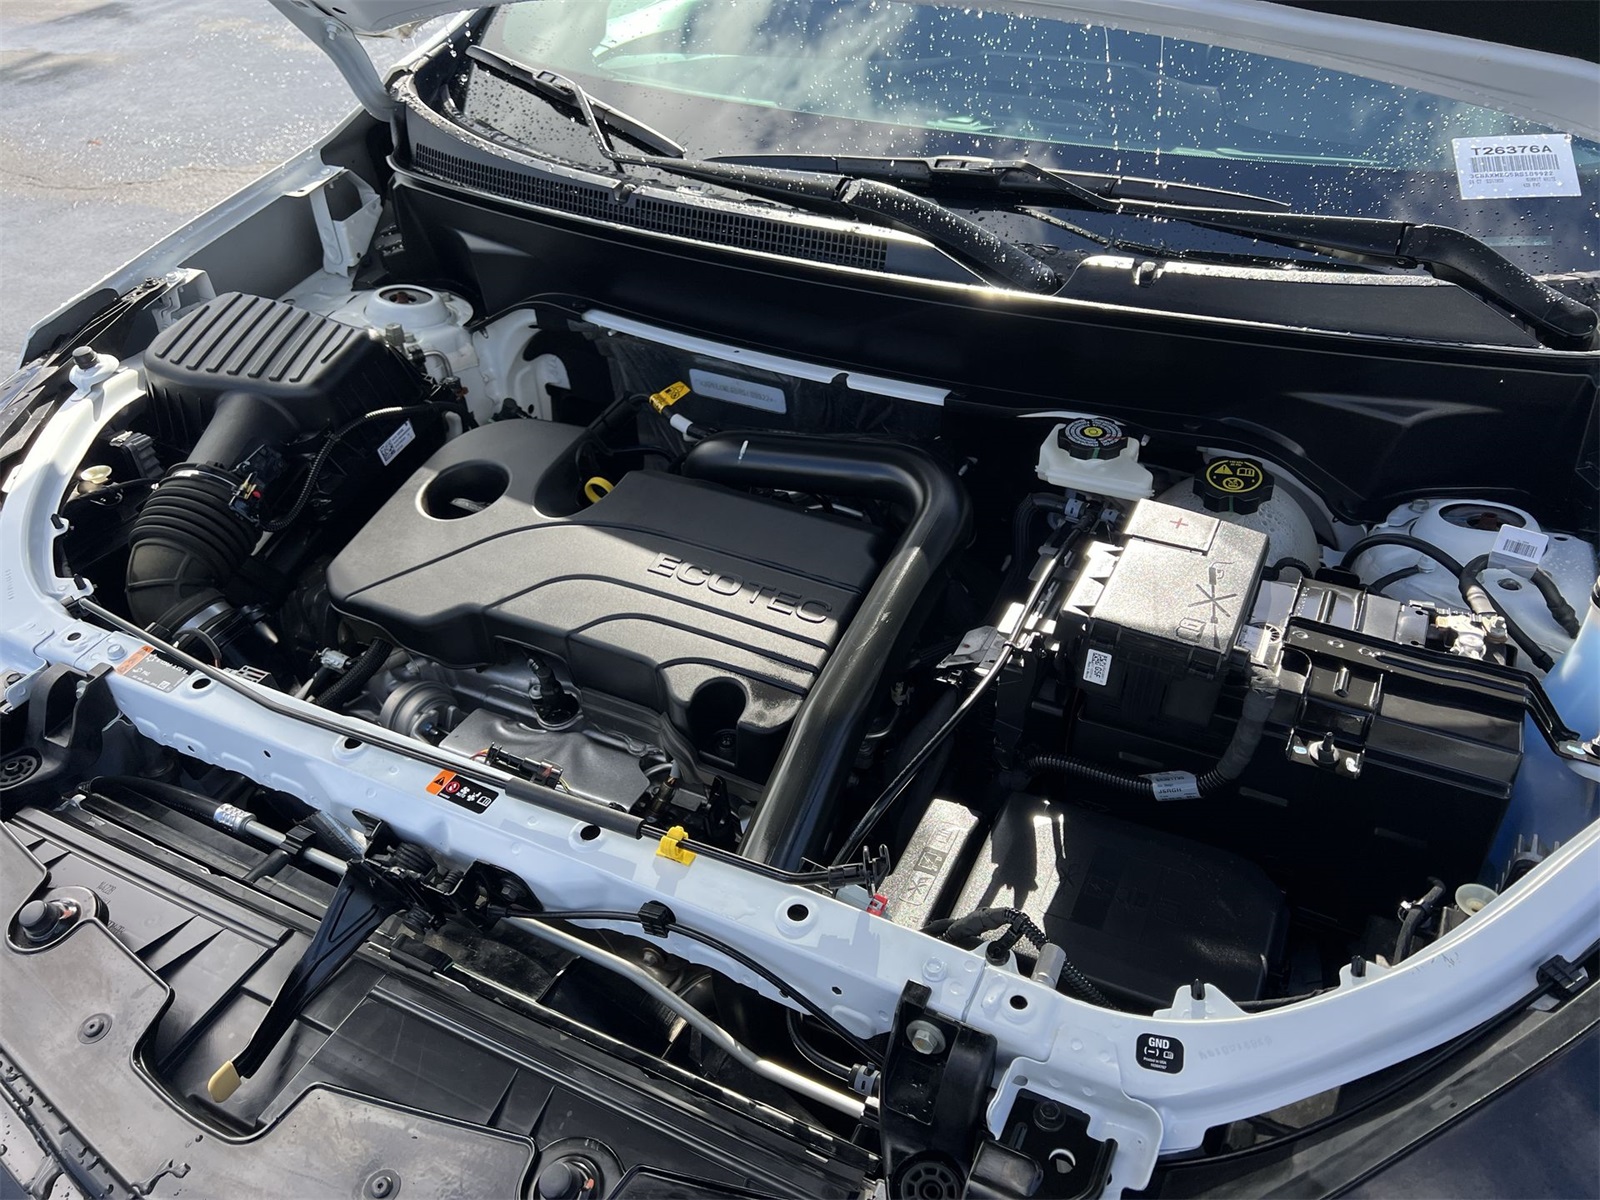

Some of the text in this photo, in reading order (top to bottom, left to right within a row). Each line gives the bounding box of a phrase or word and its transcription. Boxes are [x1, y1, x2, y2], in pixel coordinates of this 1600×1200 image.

[1471, 144, 1552, 156] T26376A
[647, 552, 832, 623] ECOTEC
[1148, 1037, 1170, 1049] GND
